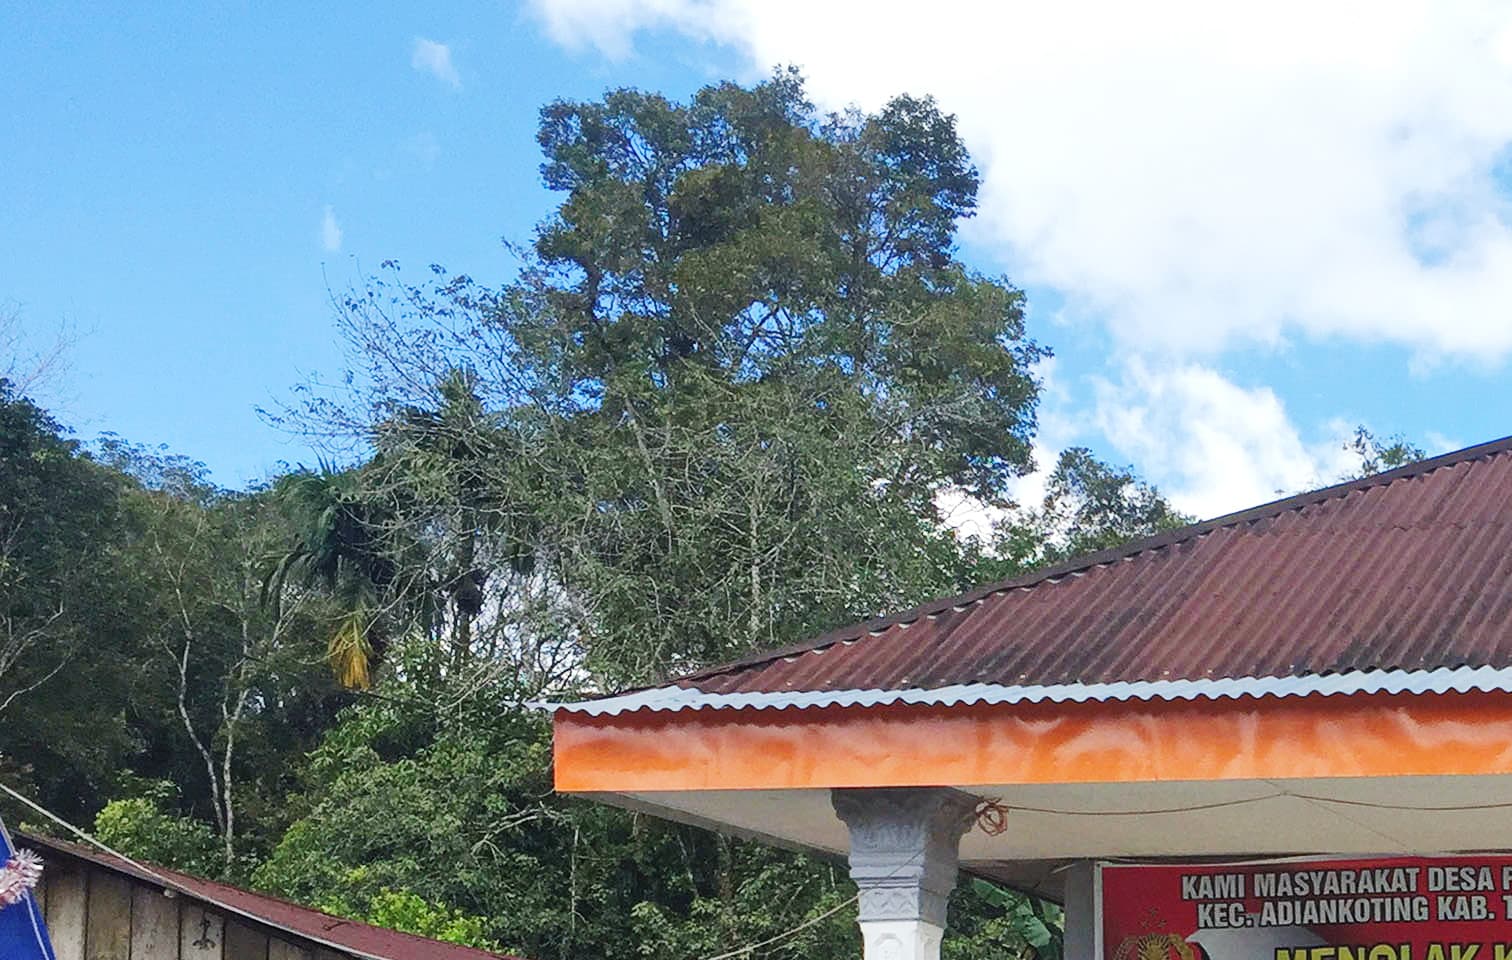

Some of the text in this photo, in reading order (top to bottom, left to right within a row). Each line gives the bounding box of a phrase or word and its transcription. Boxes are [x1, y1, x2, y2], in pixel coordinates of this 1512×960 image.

[1182, 873, 1246, 900] KAMI
[1254, 867, 1420, 898] MASYARAKAT
[1428, 865, 1494, 892] DESA
[1197, 901, 1253, 928] KEC.
[1260, 896, 1429, 926] ADIANKOTING
[1438, 895, 1495, 921] KAB.
